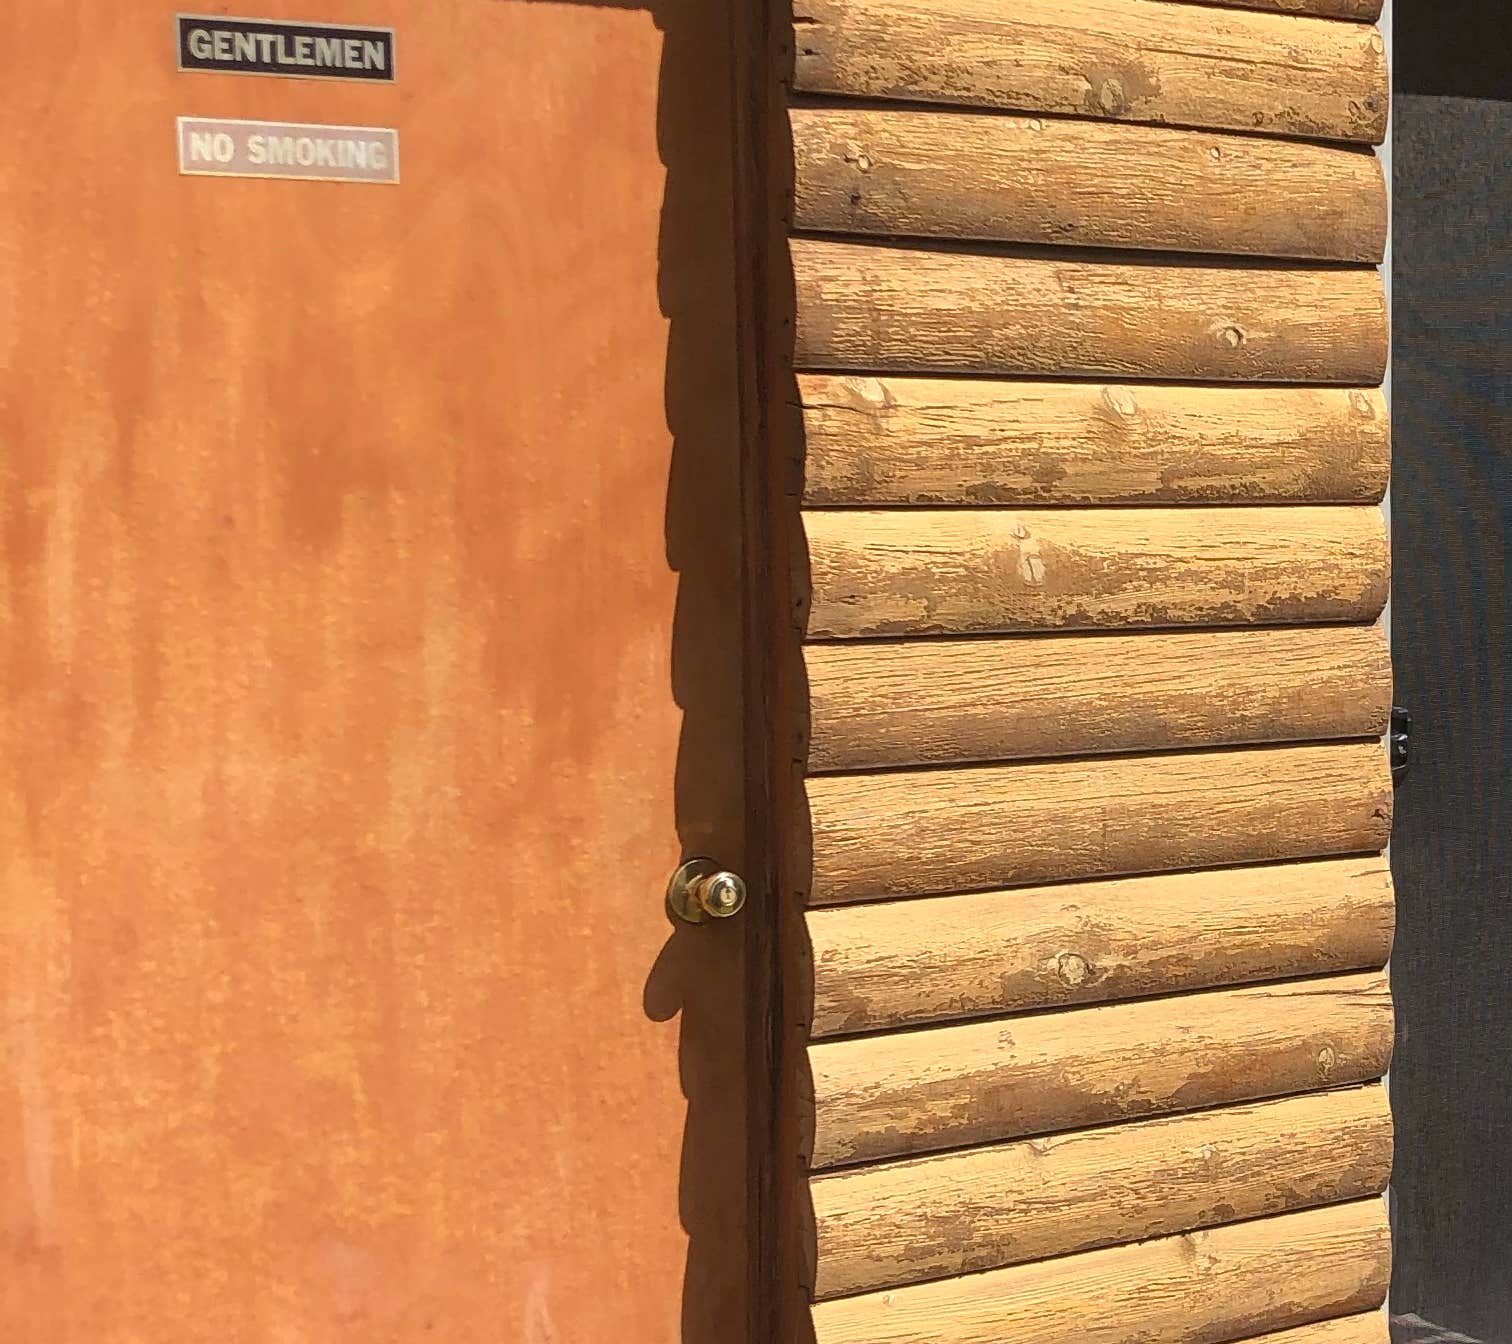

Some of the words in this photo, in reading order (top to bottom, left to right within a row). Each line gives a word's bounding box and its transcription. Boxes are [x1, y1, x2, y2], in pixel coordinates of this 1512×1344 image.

[189, 29, 385, 70] GENTLEMEN
[190, 132, 234, 162] NO
[248, 135, 387, 169] SMOKING
